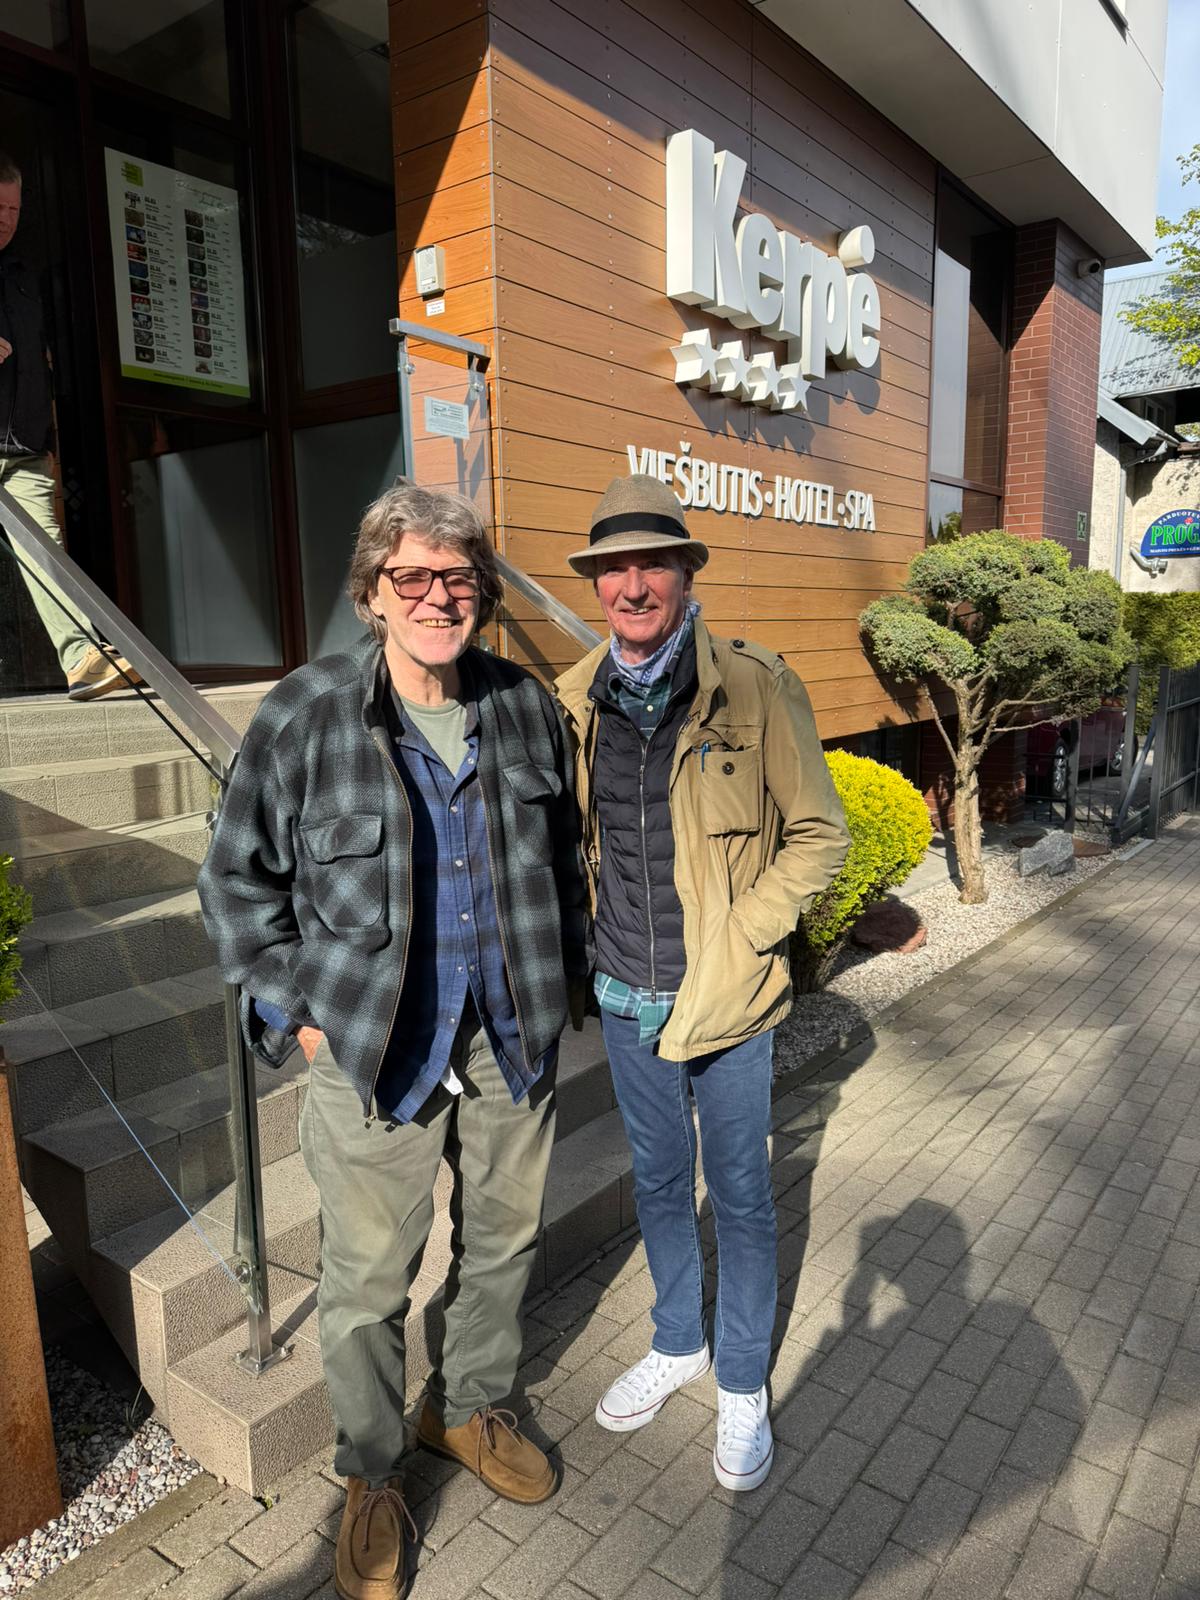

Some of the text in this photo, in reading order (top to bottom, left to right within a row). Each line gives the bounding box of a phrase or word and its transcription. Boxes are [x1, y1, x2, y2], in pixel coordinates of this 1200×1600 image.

[666, 128, 881, 380] Kerpė
[626, 441, 877, 531] VIEŠBUTIS HOTEL SPA
[1150, 523, 1200, 546] PROG
